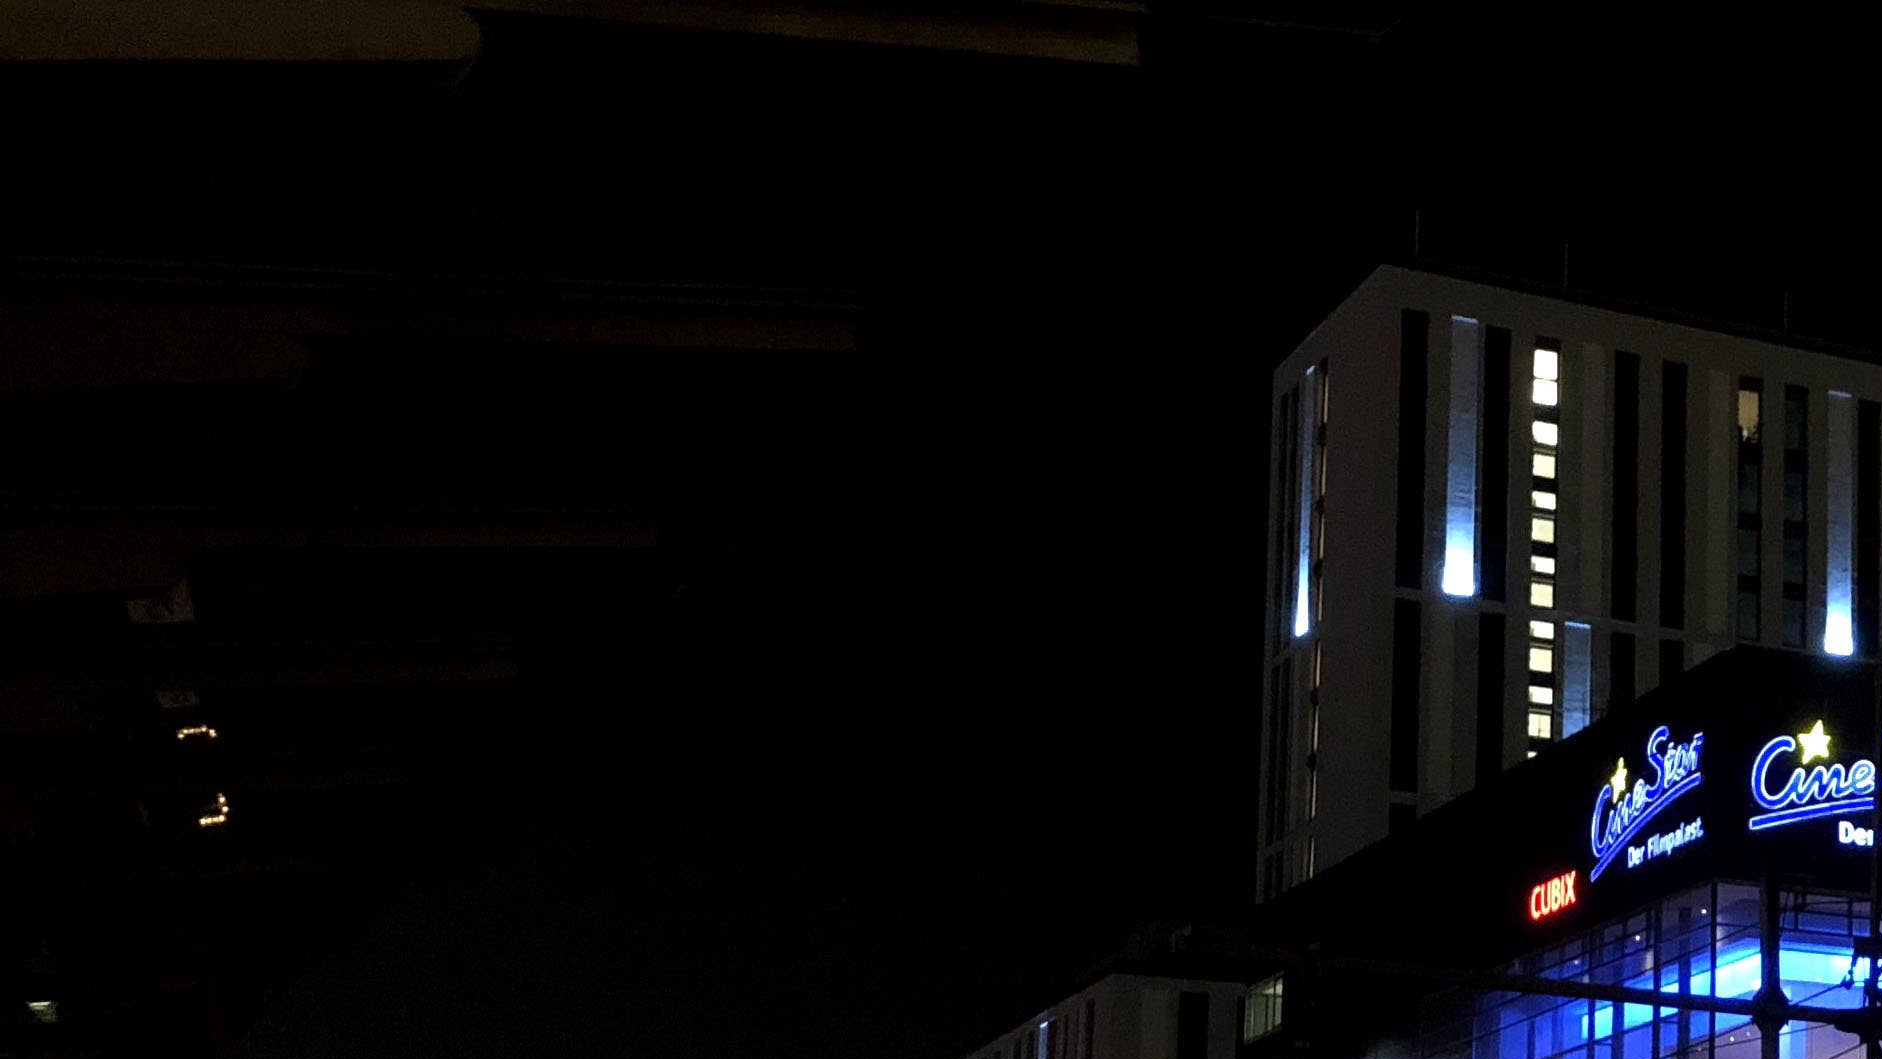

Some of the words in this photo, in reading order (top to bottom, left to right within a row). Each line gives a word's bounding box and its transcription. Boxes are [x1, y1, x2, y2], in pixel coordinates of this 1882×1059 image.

[1591, 726, 1704, 858] CineStar
[1627, 846, 1645, 868] Der
[1530, 870, 1577, 921] CUBIX
